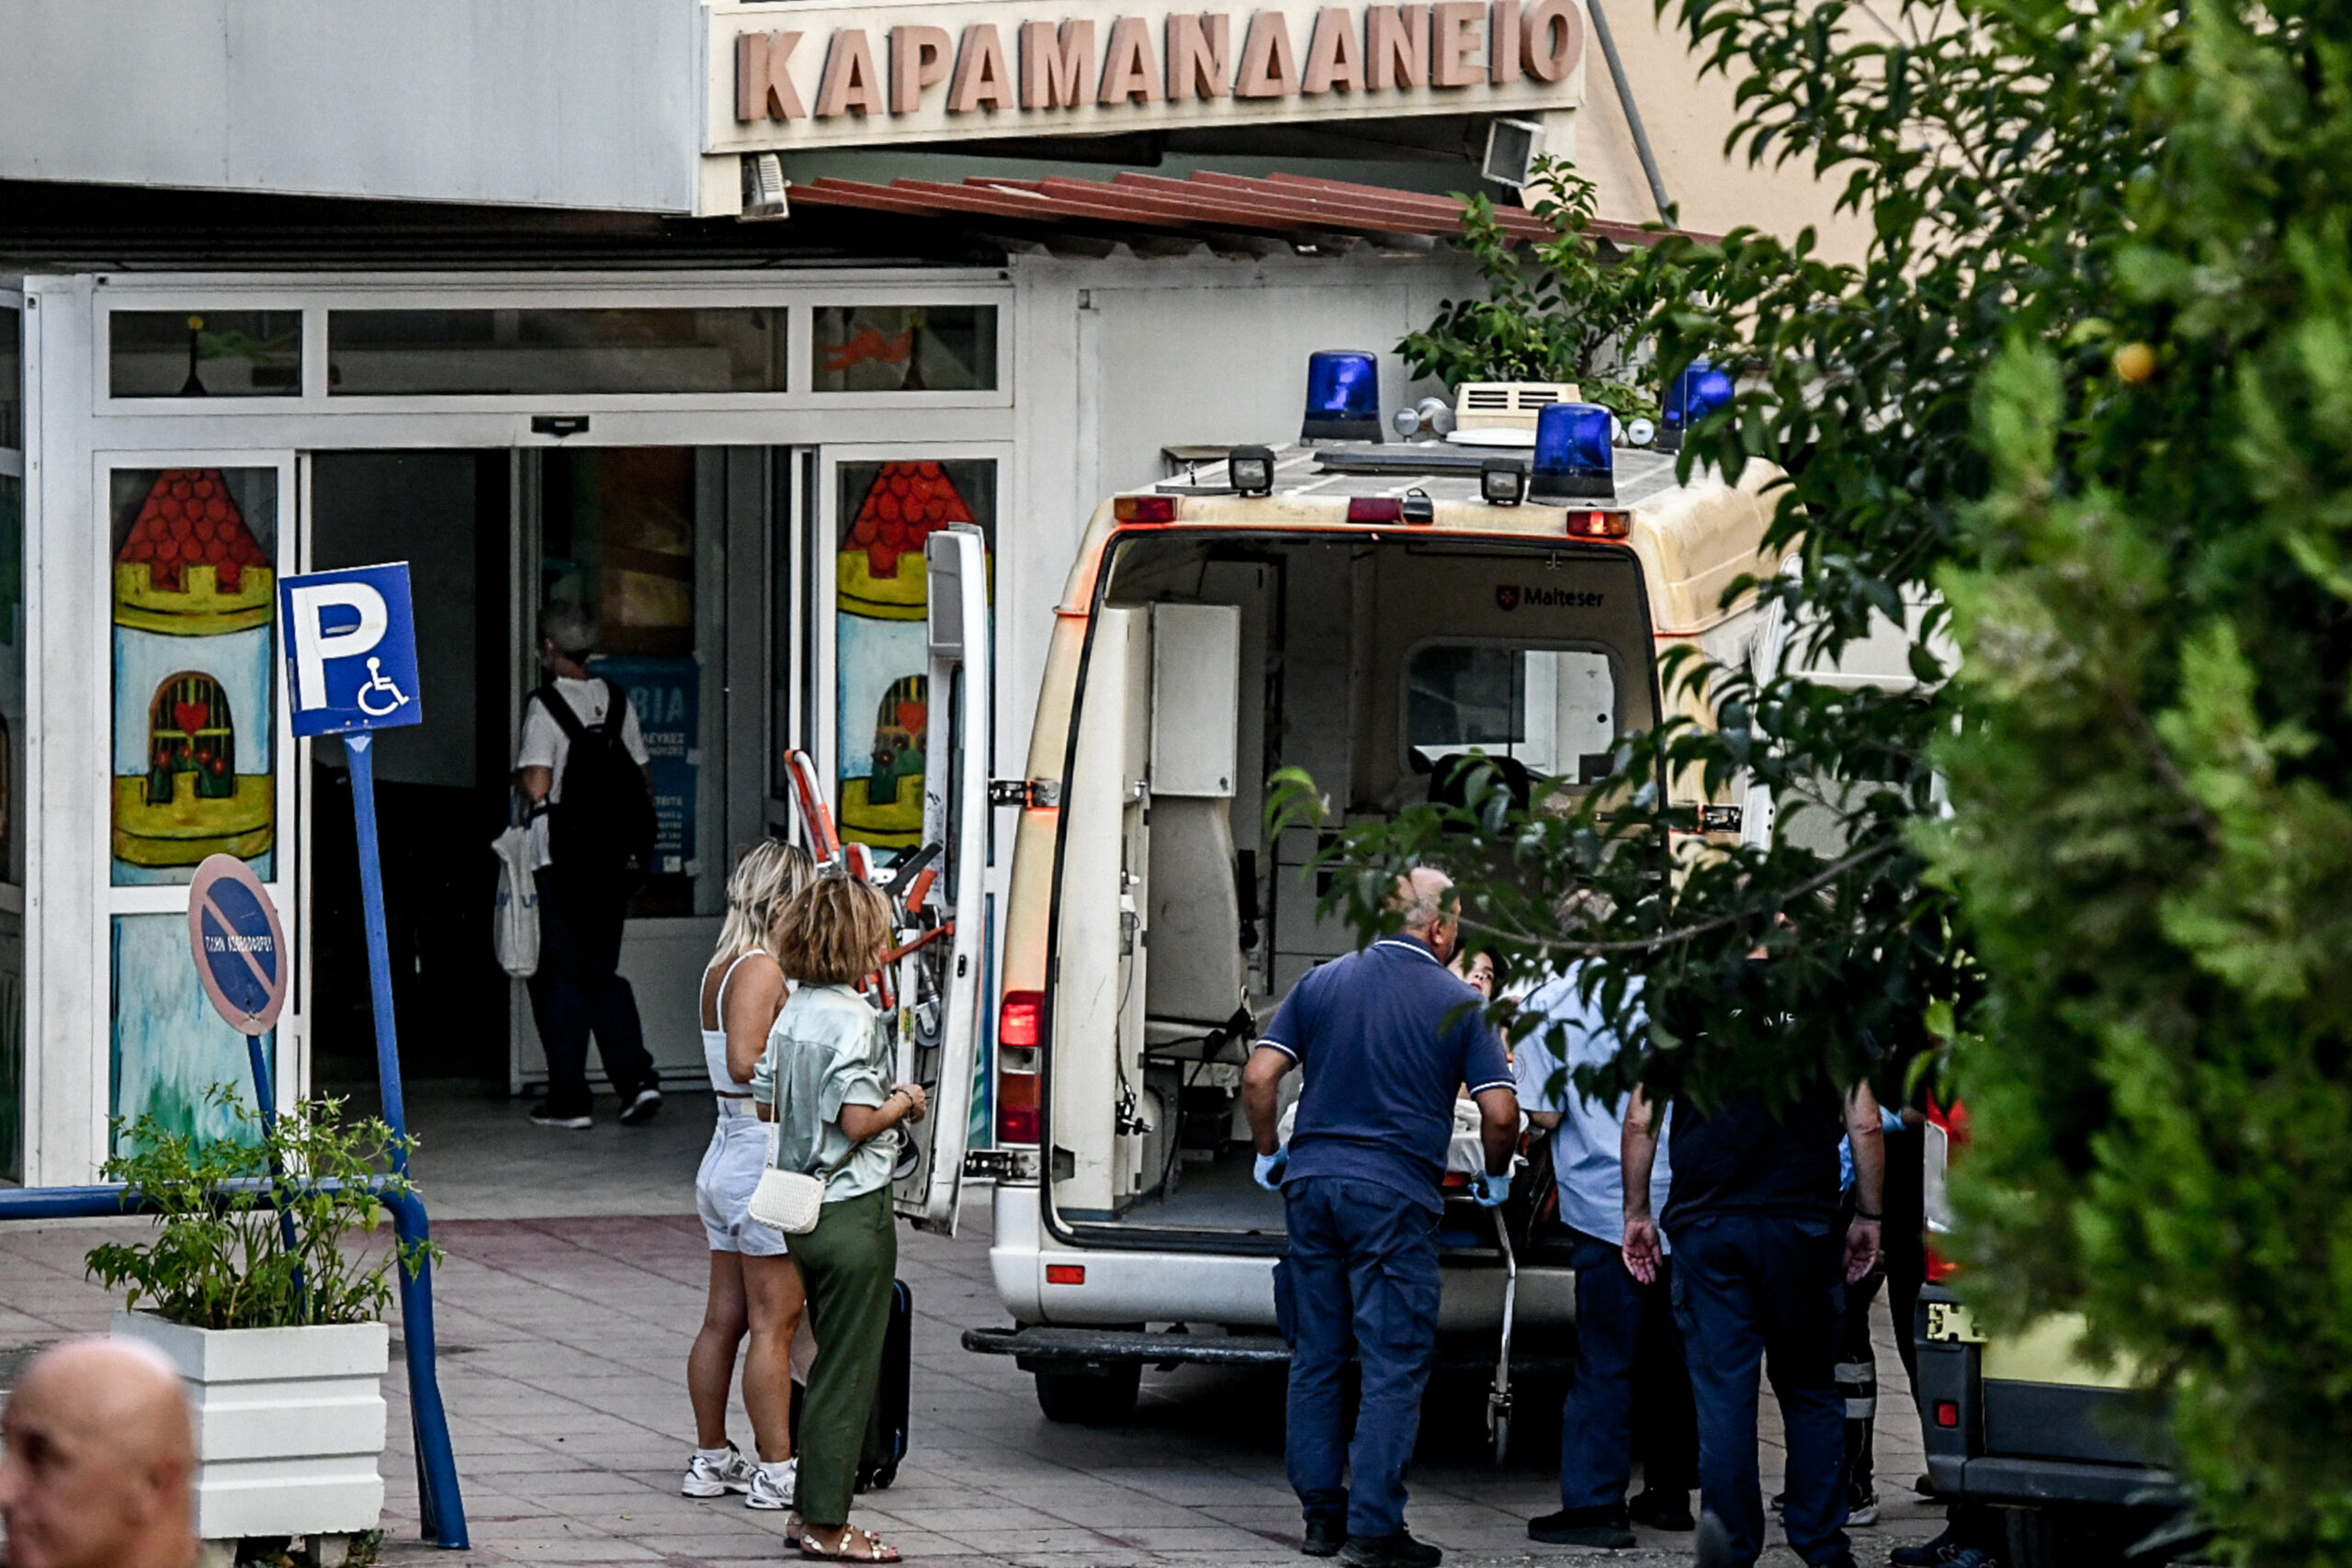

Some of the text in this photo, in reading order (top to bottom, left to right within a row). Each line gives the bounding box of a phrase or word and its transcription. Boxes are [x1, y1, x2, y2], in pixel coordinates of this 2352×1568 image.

[736, 0, 1583, 122] ΚΑΡΑΜΑΝΔΑΝΕΙΟ
[290, 582, 388, 711] P
[1523, 587, 1604, 607] Malteser
